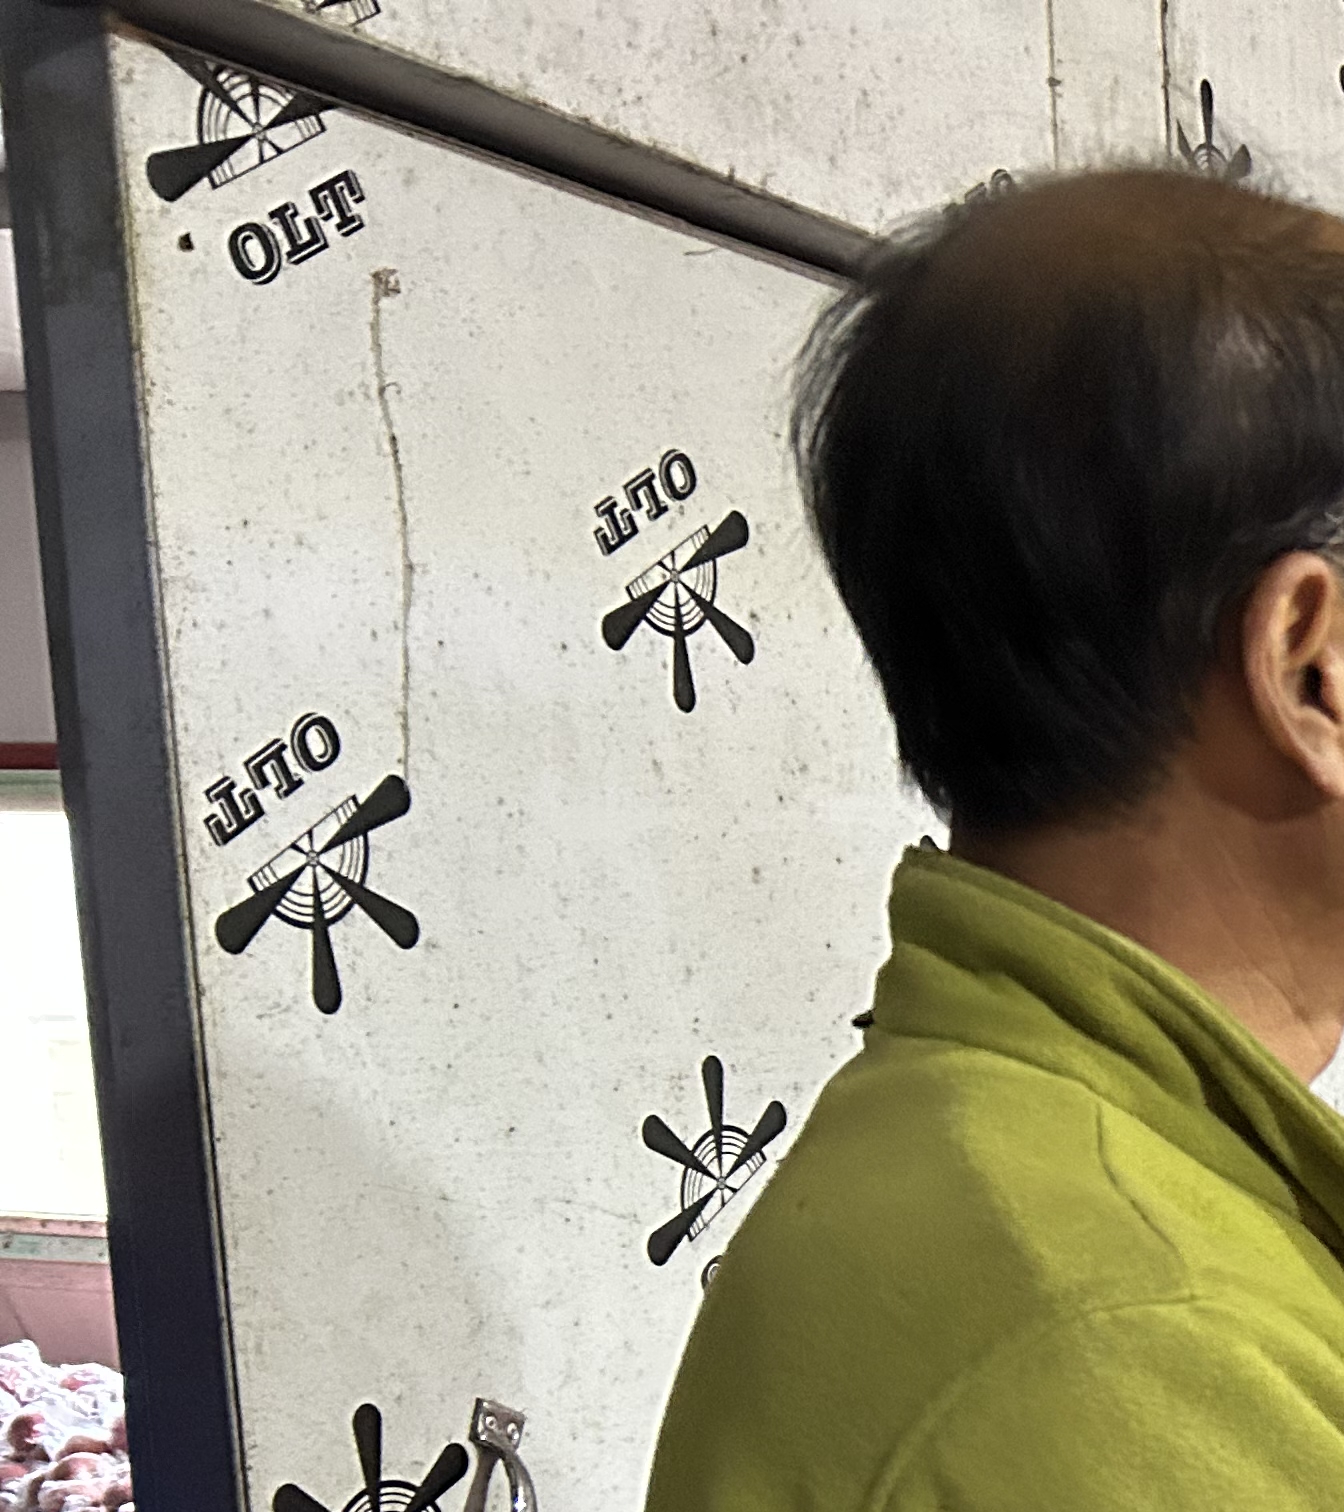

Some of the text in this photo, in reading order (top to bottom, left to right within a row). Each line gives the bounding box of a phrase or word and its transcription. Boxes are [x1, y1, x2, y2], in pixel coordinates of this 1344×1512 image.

[228, 170, 366, 282] OLT
[593, 449, 698, 556] OLT
[204, 711, 340, 846] OLT
